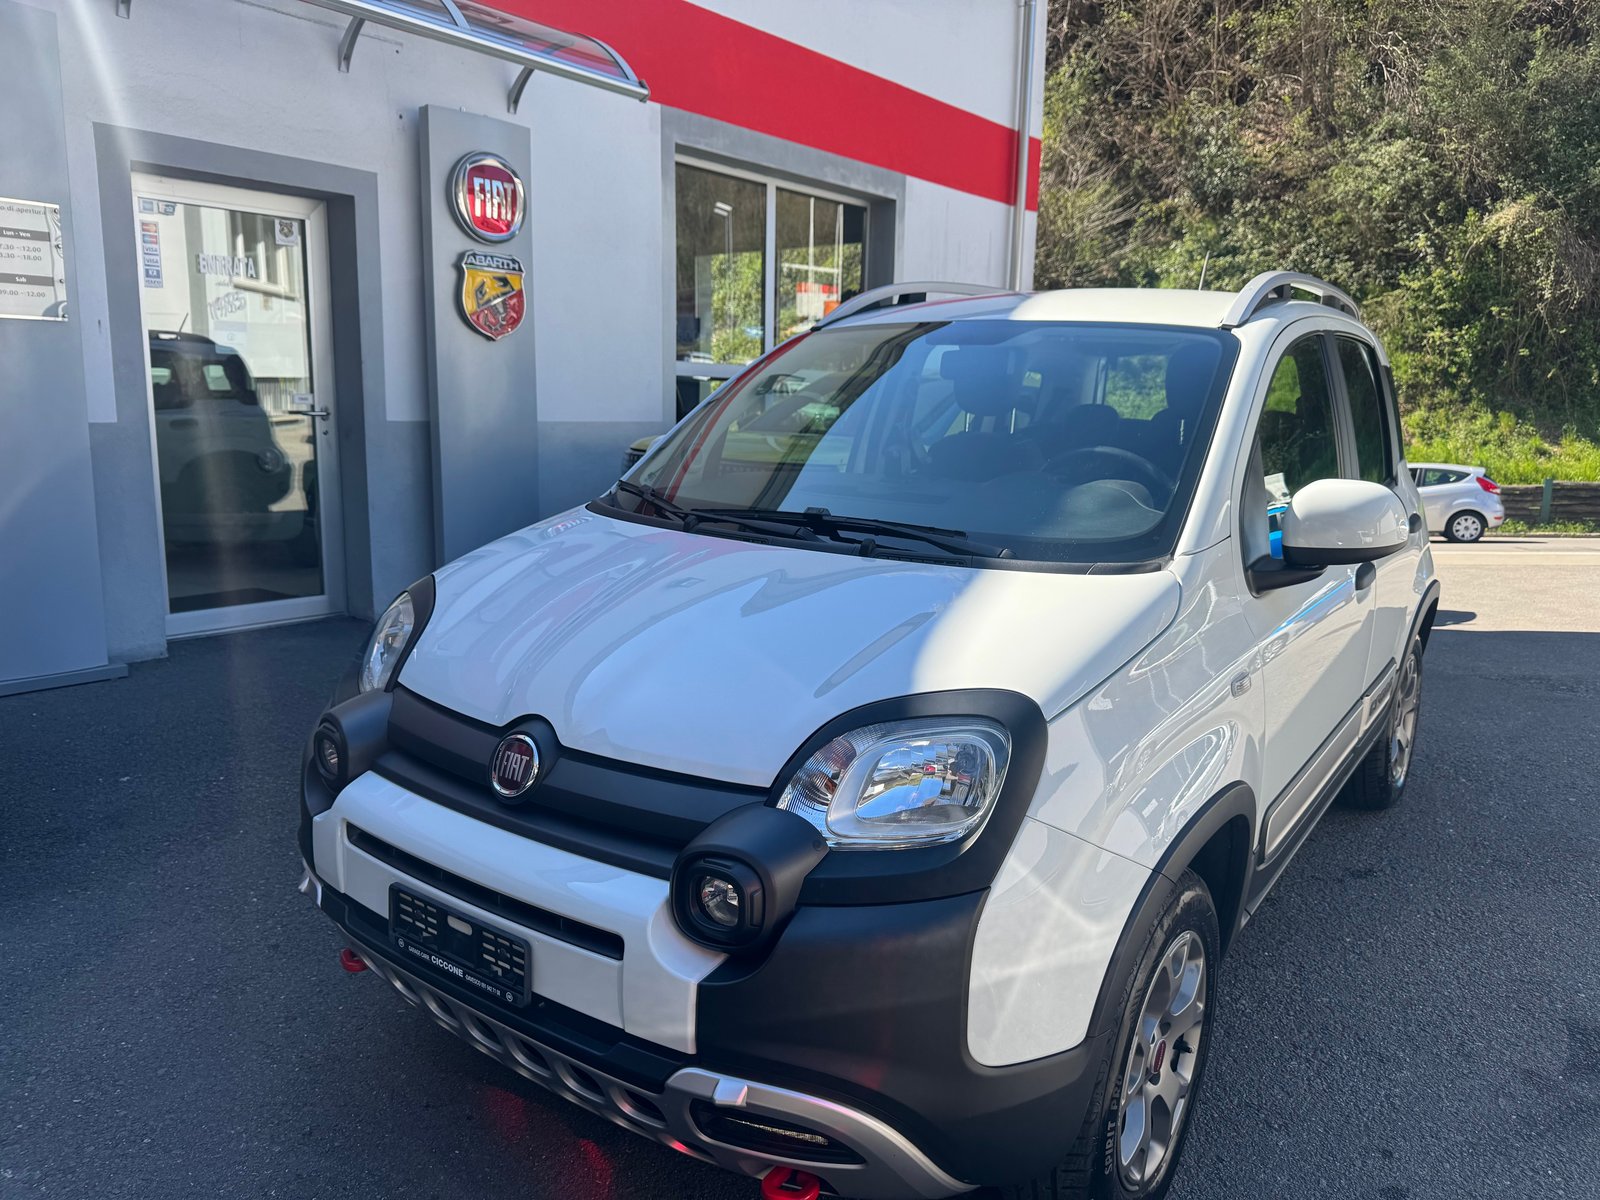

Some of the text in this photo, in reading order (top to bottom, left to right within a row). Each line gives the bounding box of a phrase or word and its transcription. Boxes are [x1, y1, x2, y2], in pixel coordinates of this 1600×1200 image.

[472, 176, 515, 221] FIAT
[3, 229, 14, 237] Lun
[22, 245, 42, 253] 12.00
[199, 253, 257, 278] ENTRATA
[466, 255, 519, 271] ABARTH
[499, 750, 530, 782] FIAT
[431, 955, 464, 978] CICCONE
[1104, 1074, 1123, 1175] SPIRIT PRO
